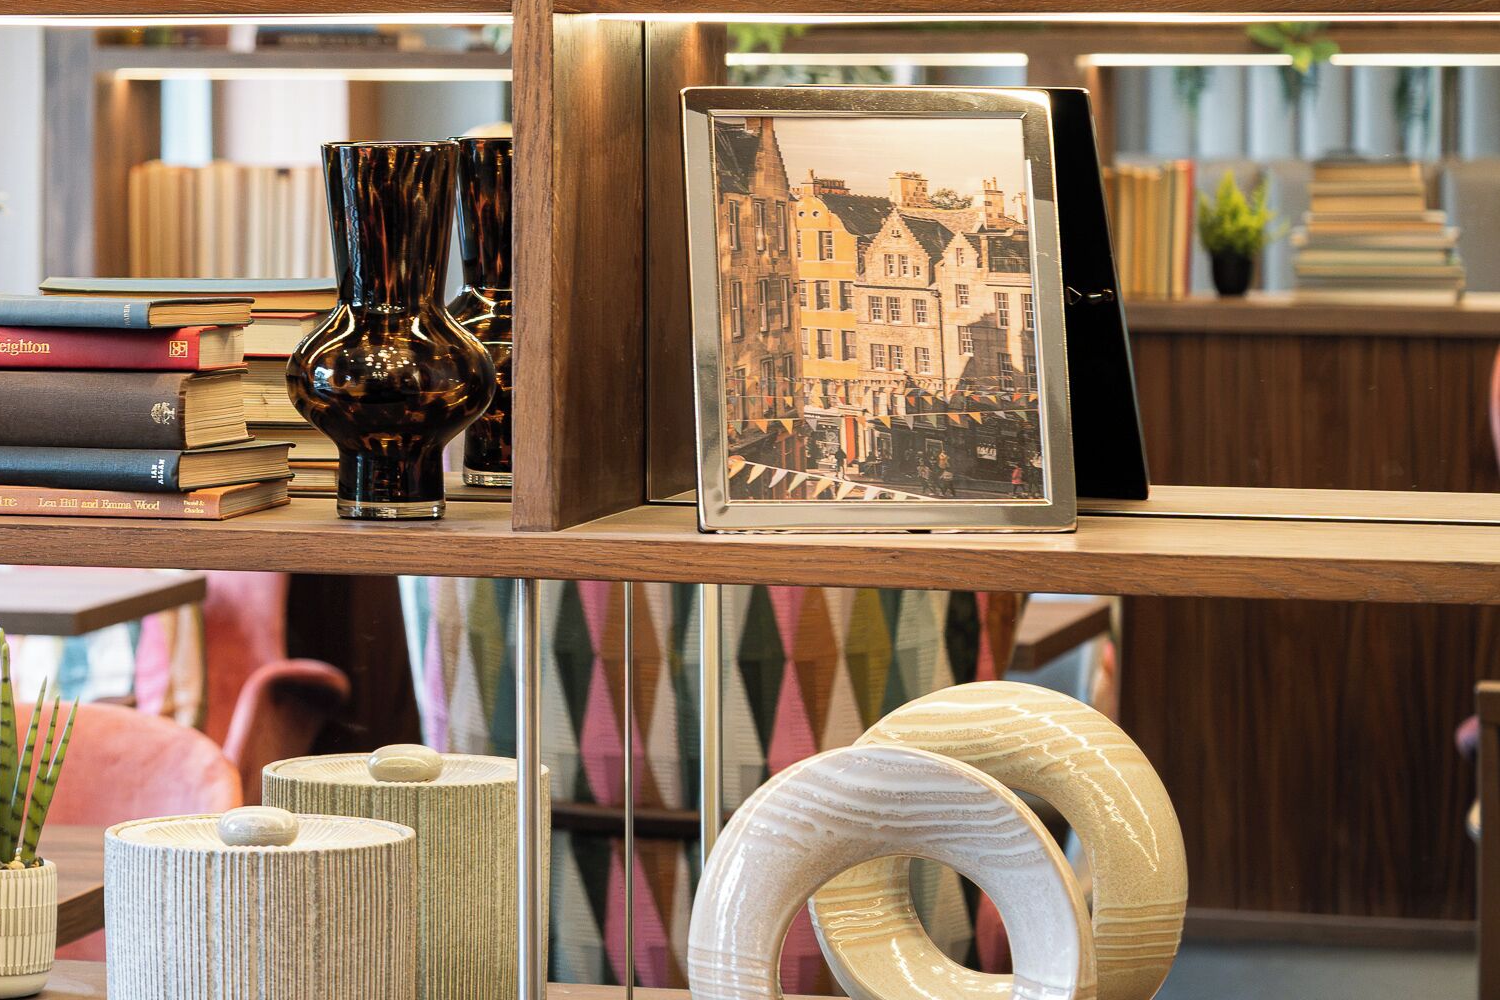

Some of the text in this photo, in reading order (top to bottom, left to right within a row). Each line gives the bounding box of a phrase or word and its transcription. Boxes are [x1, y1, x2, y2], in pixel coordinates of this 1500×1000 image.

[157, 459, 165, 485] ALLAN
[39, 497, 160, 510] Len Hill and Emma Wood
